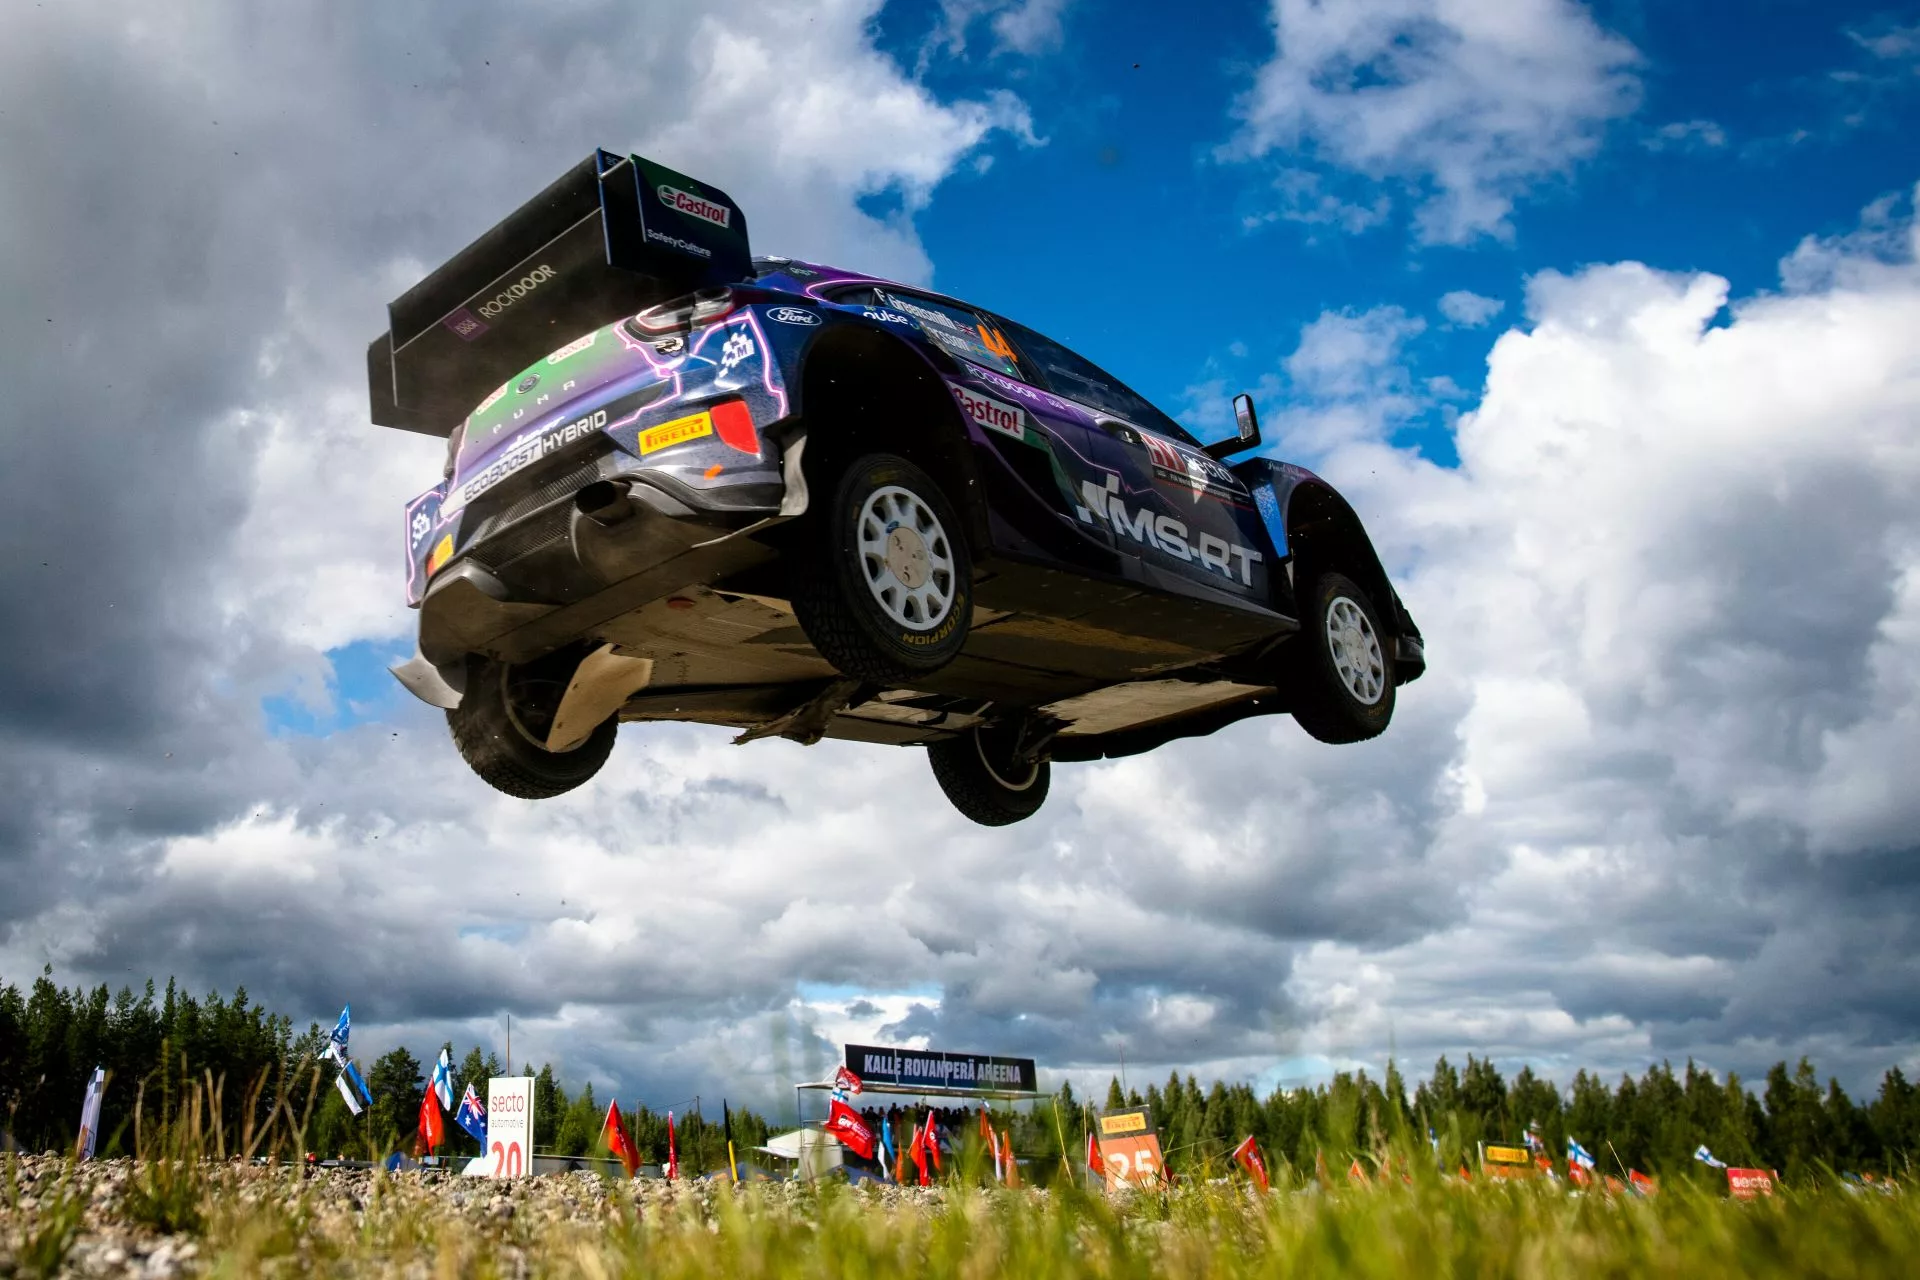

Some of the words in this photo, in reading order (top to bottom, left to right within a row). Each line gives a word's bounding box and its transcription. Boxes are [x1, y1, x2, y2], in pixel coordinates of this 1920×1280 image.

[675, 192, 726, 224] Castrol
[647, 228, 712, 257] SafetyCulture
[478, 264, 557, 318] ROCKDOOR
[777, 307, 814, 324] Ford
[976, 323, 1018, 363] 44
[542, 409, 607, 452] HYBRID
[645, 418, 704, 448] PIRELLI
[864, 1054, 902, 1075] KALLE
[904, 1057, 975, 1081] ROVANPERÄ
[977, 1063, 1022, 1084] AREENA
[491, 1092, 524, 1112] secto
[491, 1141, 522, 1180] 20
[1108, 1149, 1156, 1189] 25
